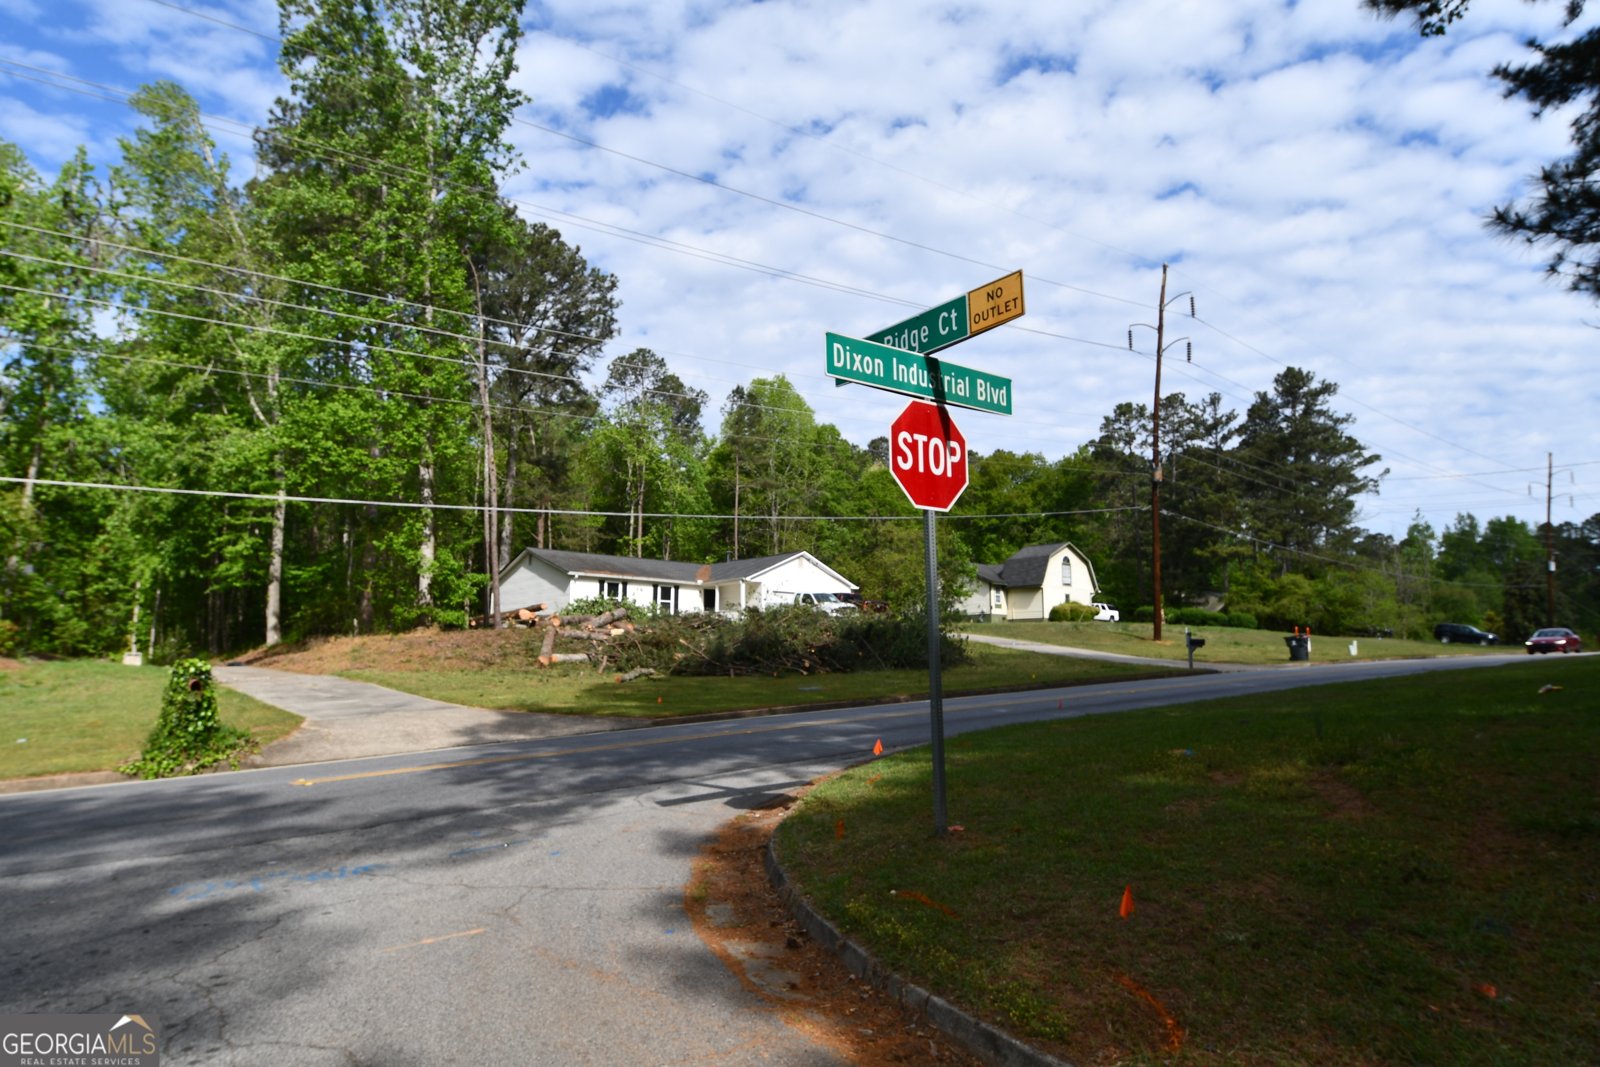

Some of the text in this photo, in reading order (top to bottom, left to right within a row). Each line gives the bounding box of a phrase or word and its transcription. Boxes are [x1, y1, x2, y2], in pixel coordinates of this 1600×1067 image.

[987, 286, 1003, 303] NO
[938, 307, 958, 336] Ct
[973, 297, 1019, 325] OUTLET
[833, 342, 1007, 407] Dixon Industrial Blvd
[896, 430, 962, 478] STOP
